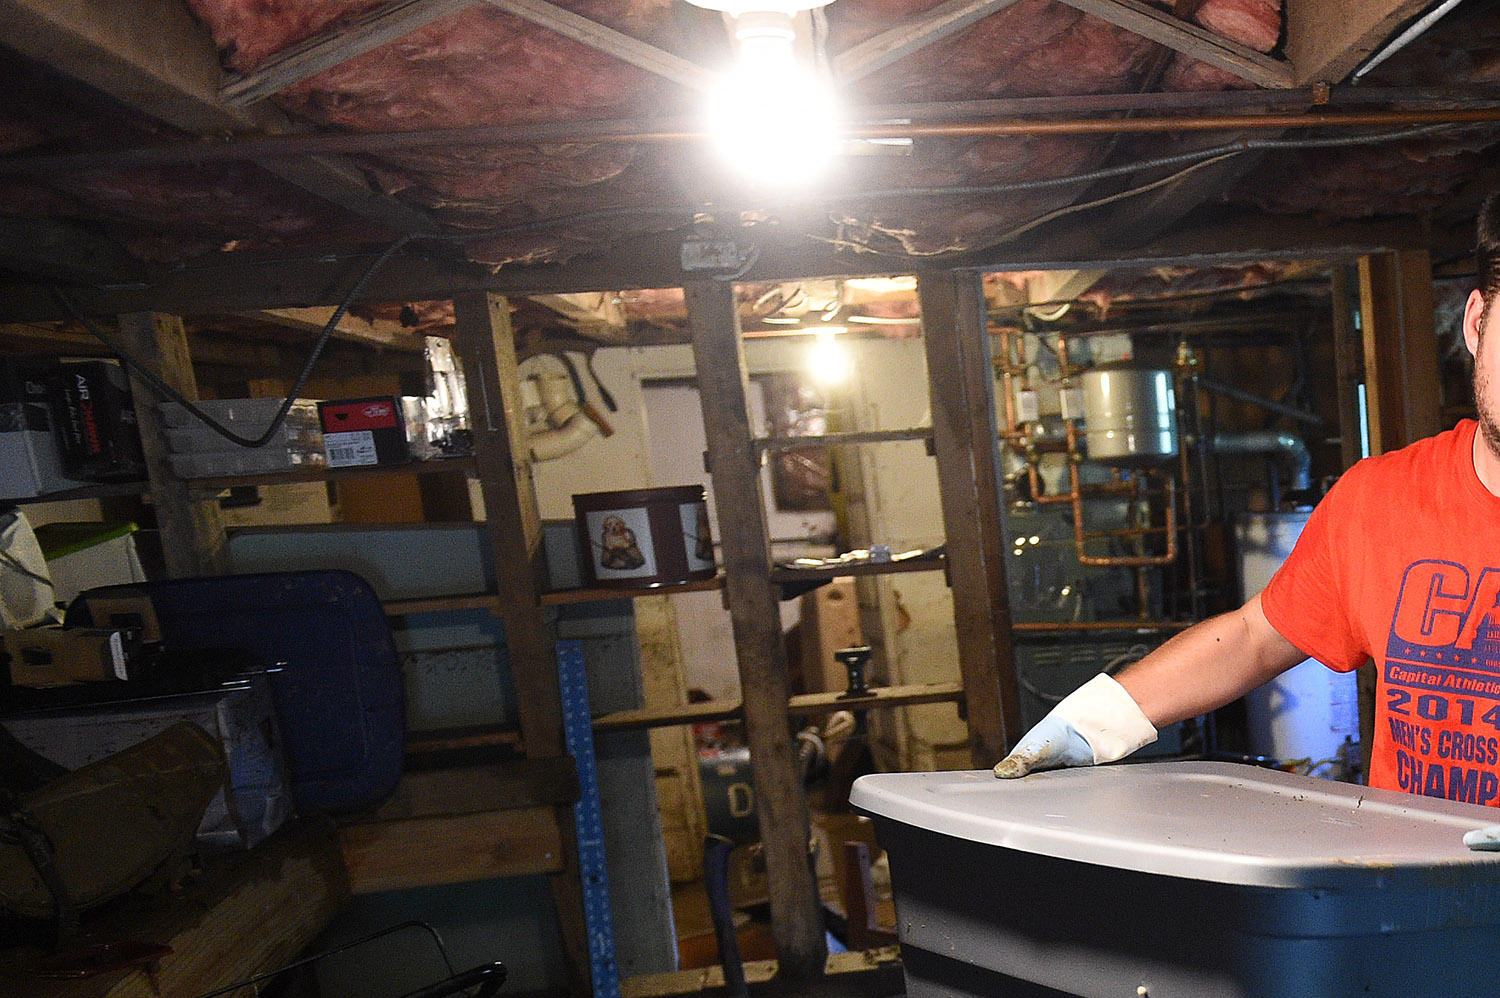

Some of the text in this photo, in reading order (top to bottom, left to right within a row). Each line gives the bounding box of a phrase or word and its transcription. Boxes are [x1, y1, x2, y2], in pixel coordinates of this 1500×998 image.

[1389, 665, 1443, 688] Capital
[1388, 716, 1432, 756] MEN'S
[1438, 729, 1498, 766] CROSS
